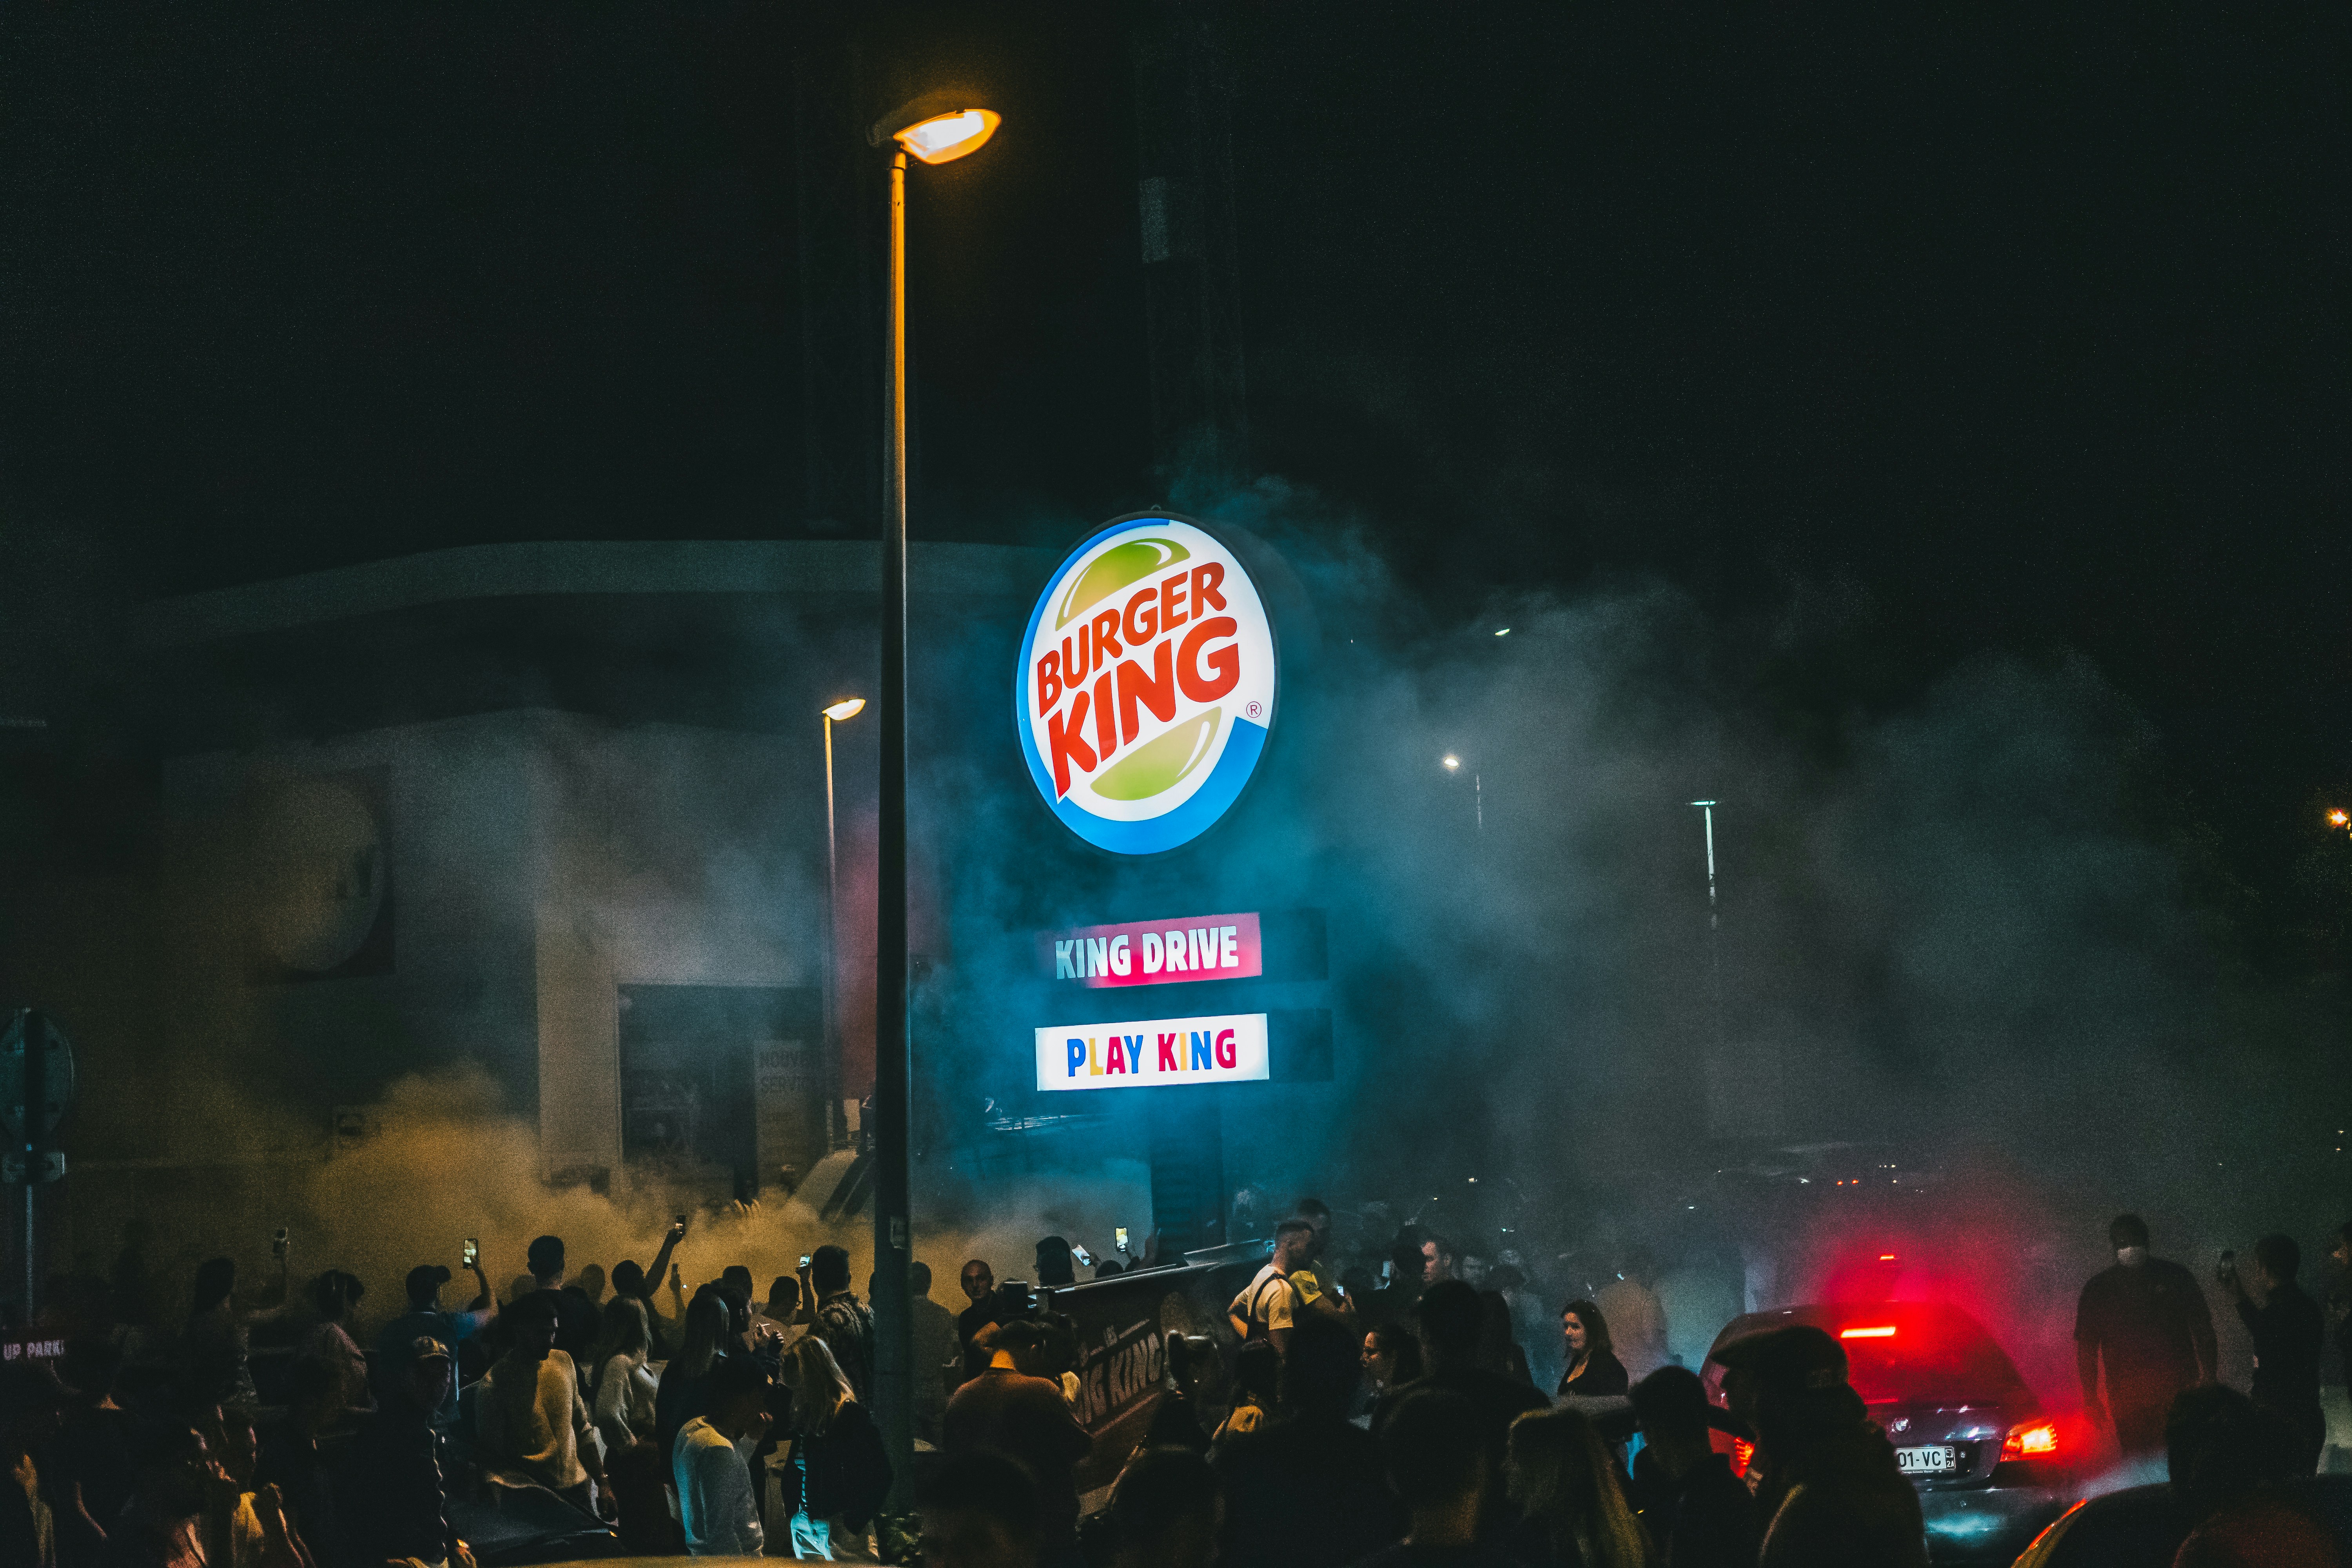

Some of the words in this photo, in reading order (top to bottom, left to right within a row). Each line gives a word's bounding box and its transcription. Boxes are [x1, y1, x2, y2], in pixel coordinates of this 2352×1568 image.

[1037, 563, 1227, 718] BURGER
[1048, 616, 1240, 798] KING
[1055, 935, 1131, 980] KING
[1142, 926, 1239, 973] DRIVE
[1067, 1035, 1143, 1077] PLAY
[1158, 1029, 1236, 1072] KING
[1077, 1363, 1107, 1425] IG
[1109, 1332, 1162, 1408] KING
